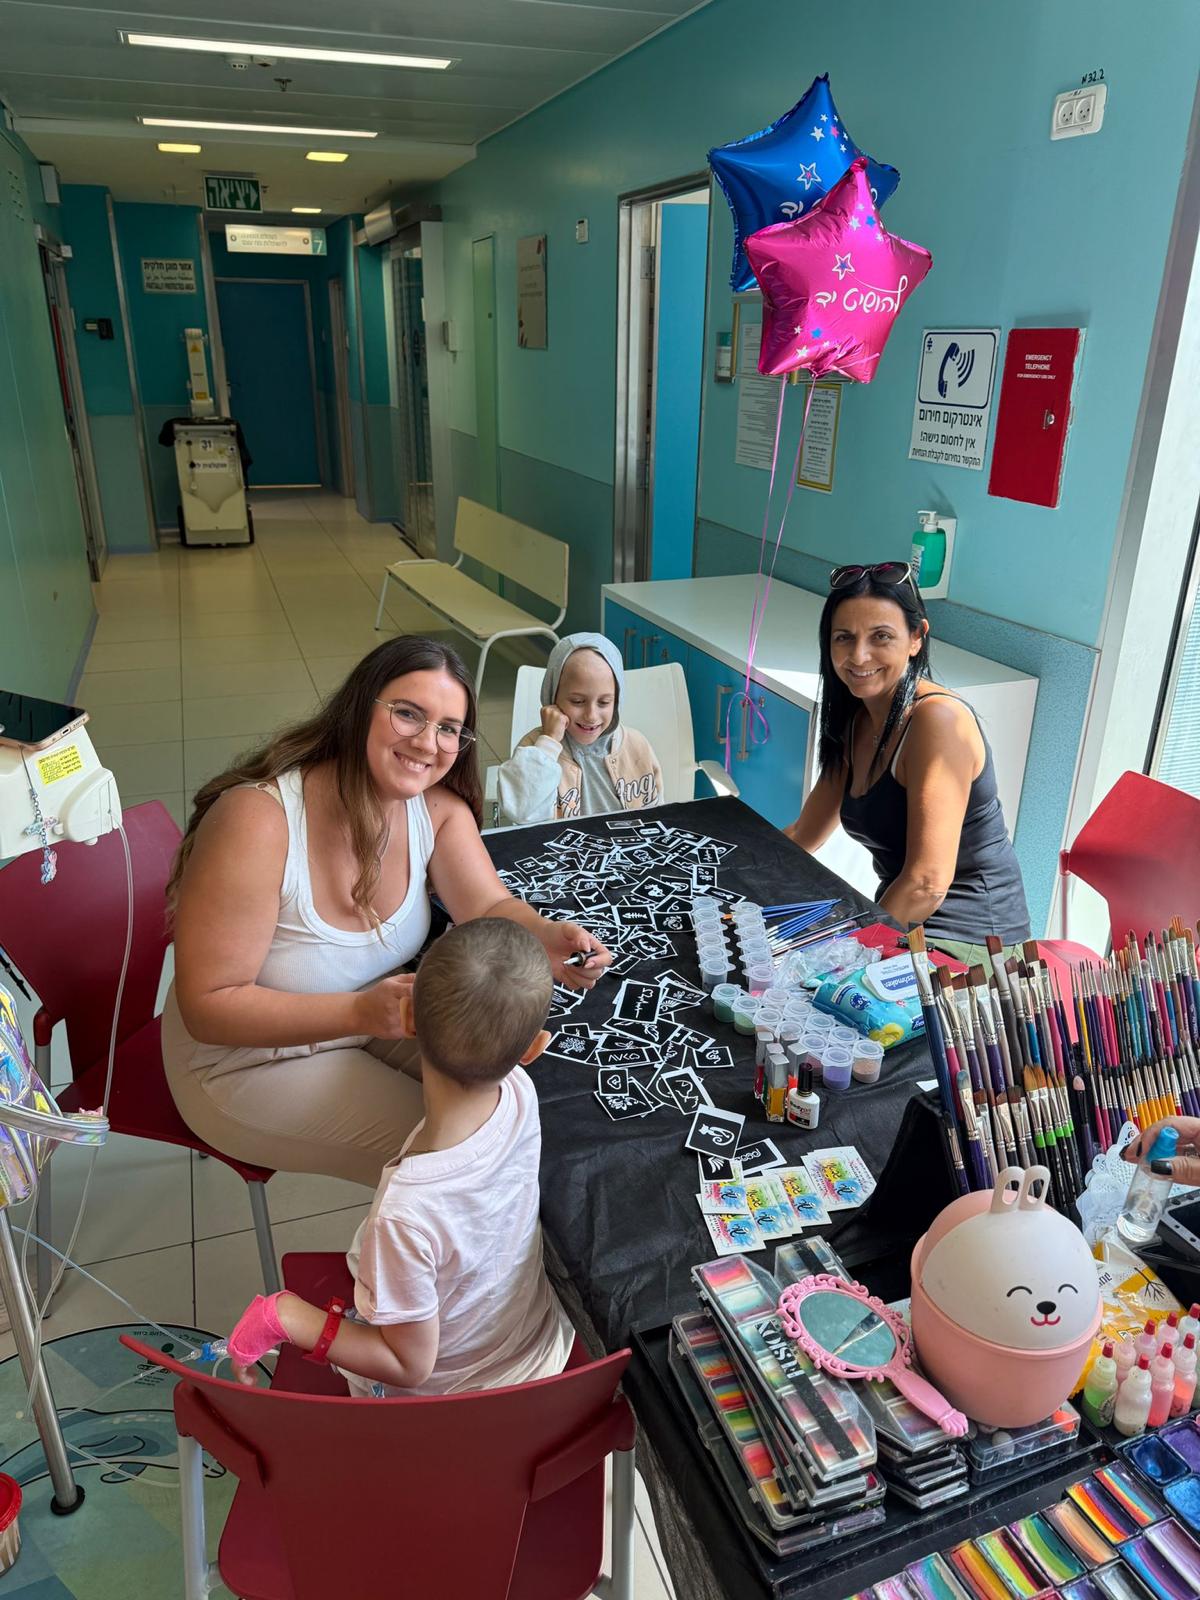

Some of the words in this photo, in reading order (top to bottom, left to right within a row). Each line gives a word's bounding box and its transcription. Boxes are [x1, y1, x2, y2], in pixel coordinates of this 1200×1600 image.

[207, 178, 249, 209] יציאה
[314, 239, 323, 254] 7
[1025, 363, 1050, 371] TELEPHONE
[919, 408, 941, 422] חירום
[943, 411, 983, 428] אינטרקום
[920, 430, 939, 444] גישה!
[941, 433, 964, 448] לחסום
[964, 437, 976, 451] אין
